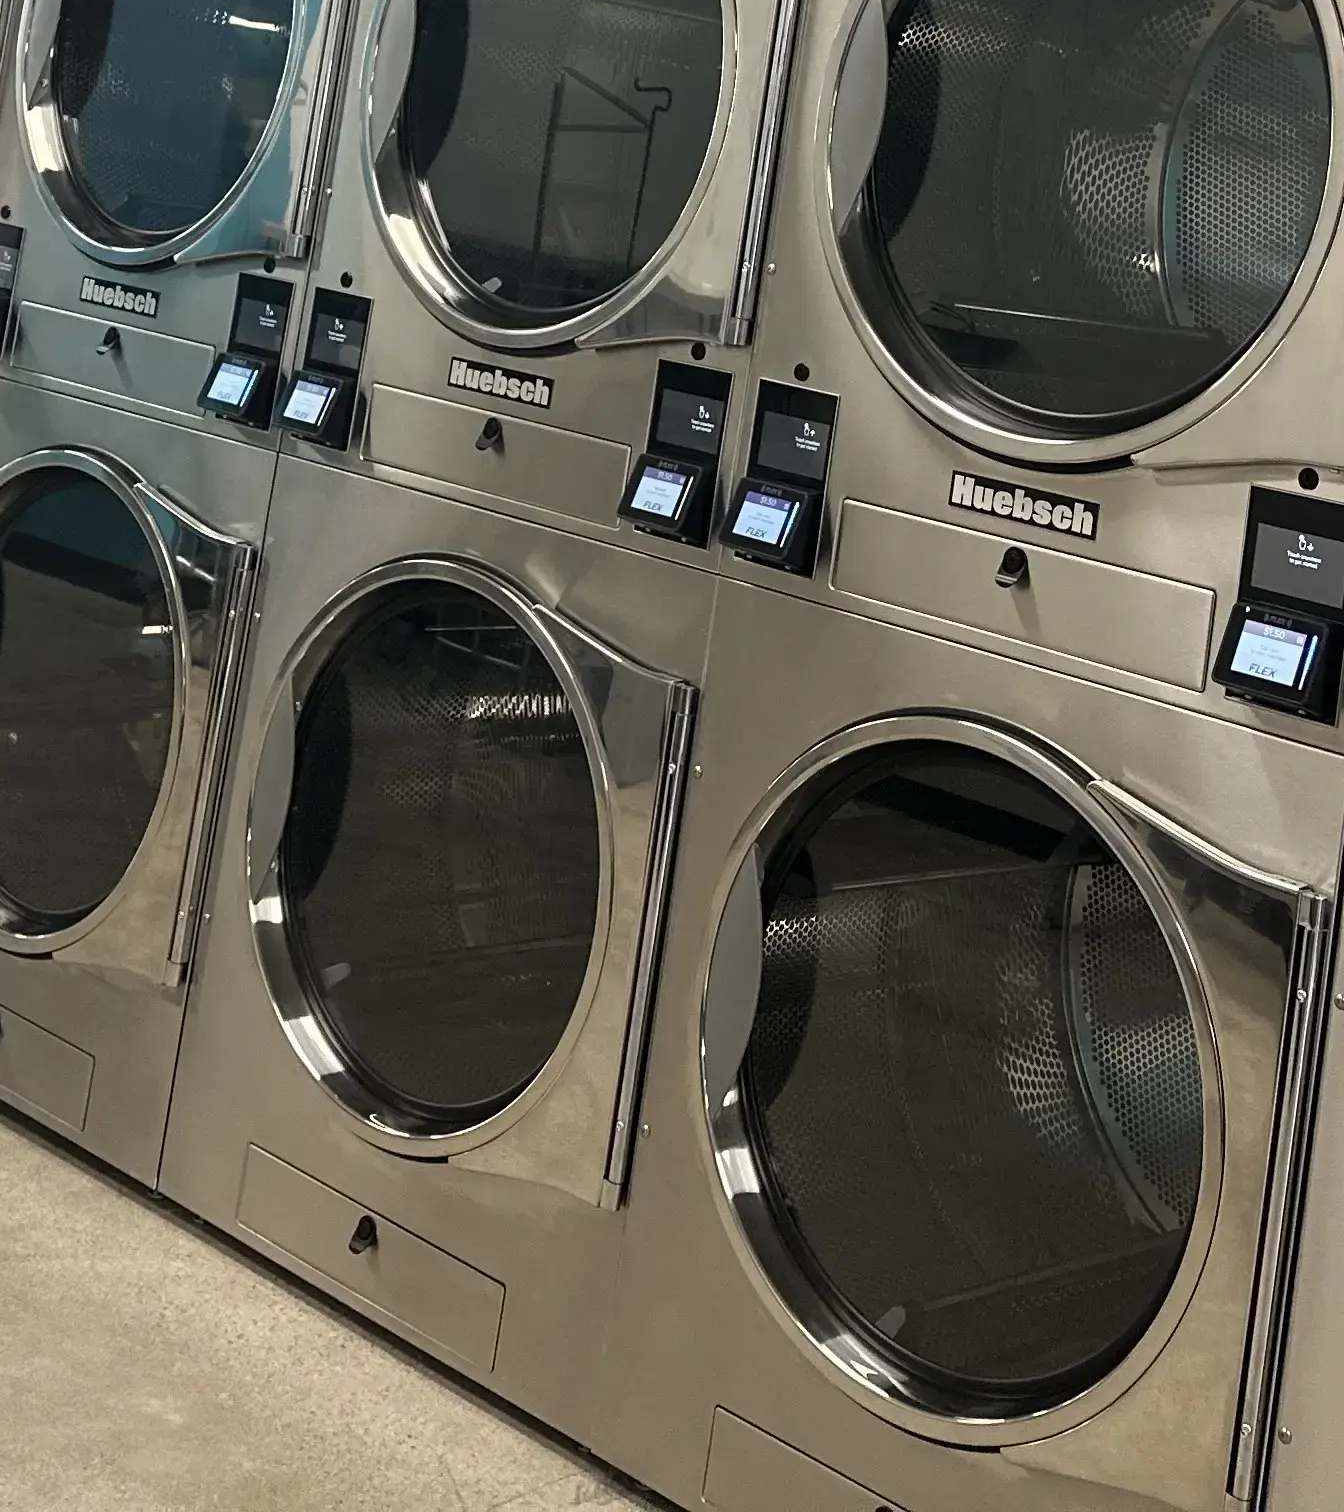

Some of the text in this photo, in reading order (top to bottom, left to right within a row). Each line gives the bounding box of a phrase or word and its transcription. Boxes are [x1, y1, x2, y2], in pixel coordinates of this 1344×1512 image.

[81, 277, 157, 316] Huebsch
[449, 359, 550, 406] Huebsch
[951, 474, 1094, 536] Huebsch
[745, 526, 768, 539] FLEX
[1249, 663, 1278, 678] FLEX
